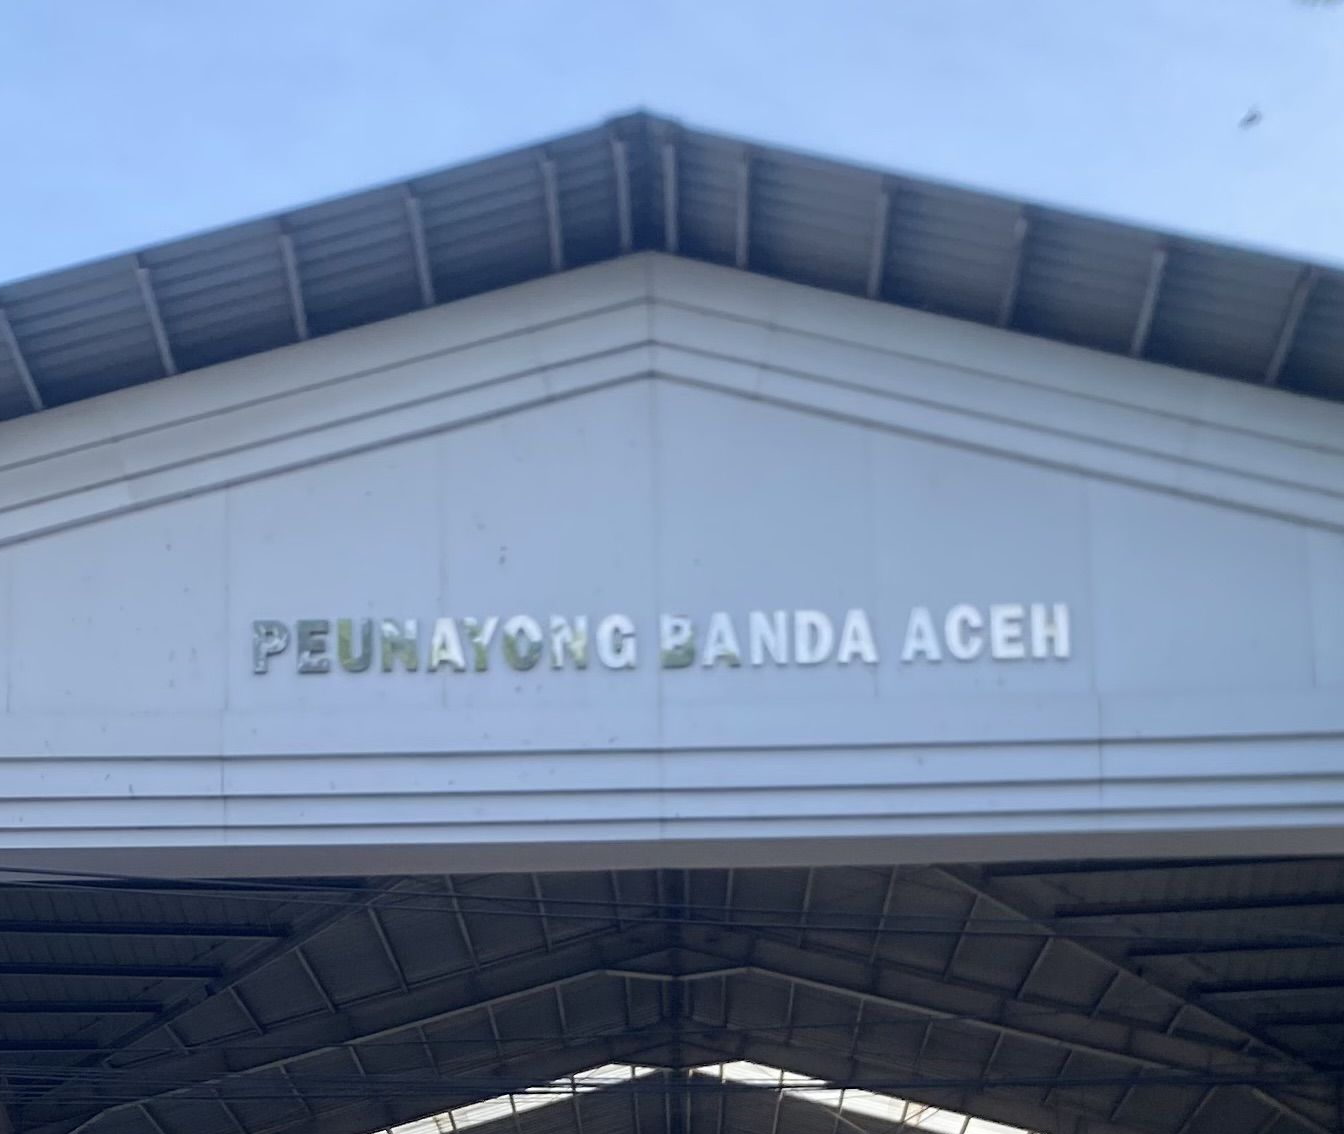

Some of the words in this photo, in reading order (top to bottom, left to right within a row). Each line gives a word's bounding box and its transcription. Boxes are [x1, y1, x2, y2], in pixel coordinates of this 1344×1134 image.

[253, 612, 638, 675] PEUNAYONG
[660, 605, 880, 670] BANDA
[901, 601, 1073, 664] ACEH
